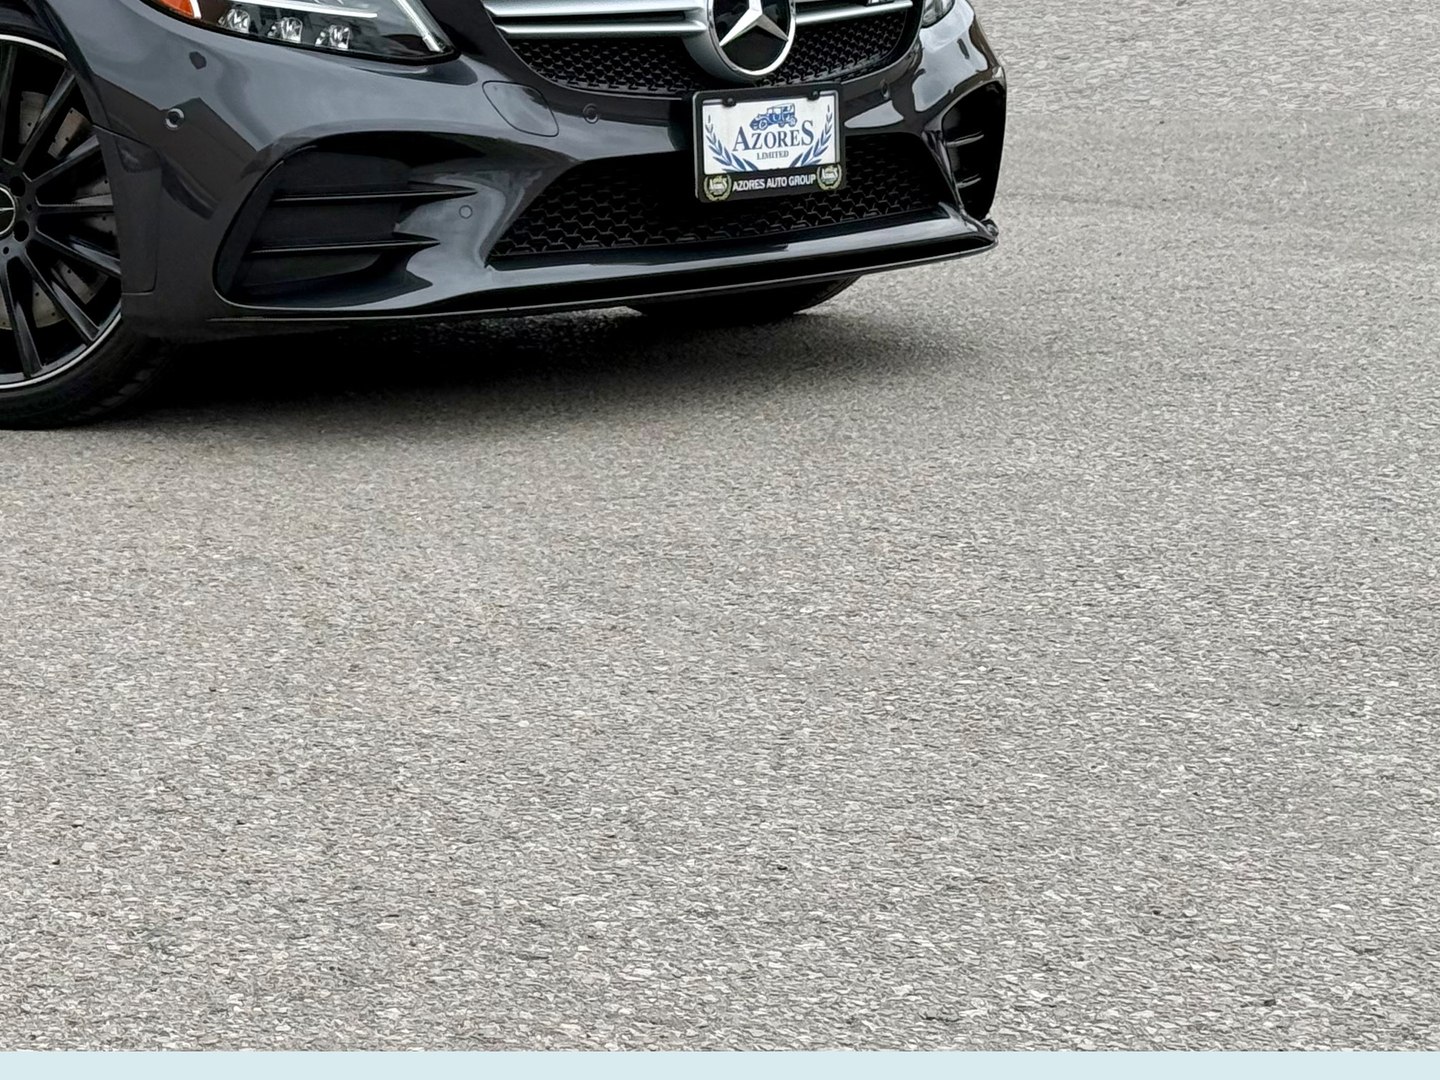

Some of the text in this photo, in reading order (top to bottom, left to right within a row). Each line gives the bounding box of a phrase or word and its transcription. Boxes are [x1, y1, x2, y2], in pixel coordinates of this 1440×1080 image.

[732, 119, 815, 152] AZORES
[756, 150, 790, 161] LIMITED
[732, 178, 765, 192] AZORES
[766, 176, 788, 189] AUTO
[788, 173, 817, 187] GROUP
